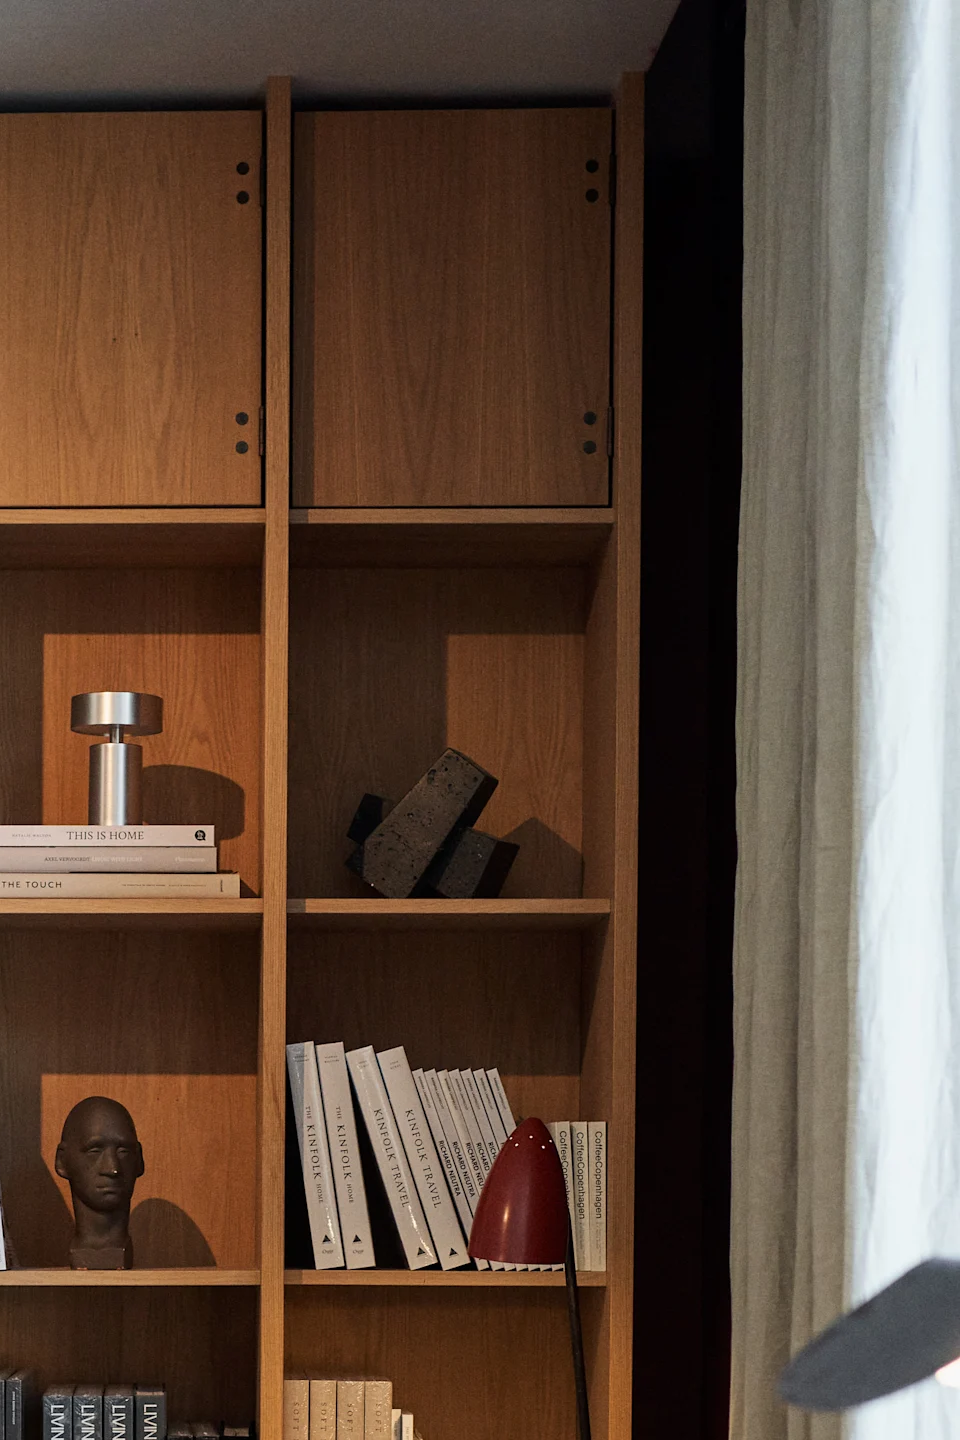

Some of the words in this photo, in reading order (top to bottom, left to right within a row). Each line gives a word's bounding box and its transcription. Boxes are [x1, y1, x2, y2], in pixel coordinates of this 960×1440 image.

[66, 831, 94, 840] THIS
[96, 831, 106, 840] IS
[109, 831, 144, 840] HOME
[2, 881, 22, 889] THE
[25, 881, 62, 889] TOUCH
[306, 1124, 322, 1180] KINFOLK
[316, 1183, 324, 1204] HOME
[336, 1124, 352, 1180] KINFOLK
[346, 1183, 354, 1204] HOME
[373, 1108, 396, 1162] KINFOLK
[390, 1164, 410, 1208] TRAVEL
[404, 1108, 428, 1162] KINFOLK
[422, 1164, 442, 1208] TRAVEL
[438, 1140, 452, 1168] RICHARD
[448, 1170, 461, 1196] NEUTRA
[452, 1141, 466, 1170] RICHARD
[462, 1171, 476, 1198] NEUTRA
[576, 1132, 586, 1220] CoffeeCopenhagen
[594, 1131, 602, 1218] CoffeeCopenhagen
